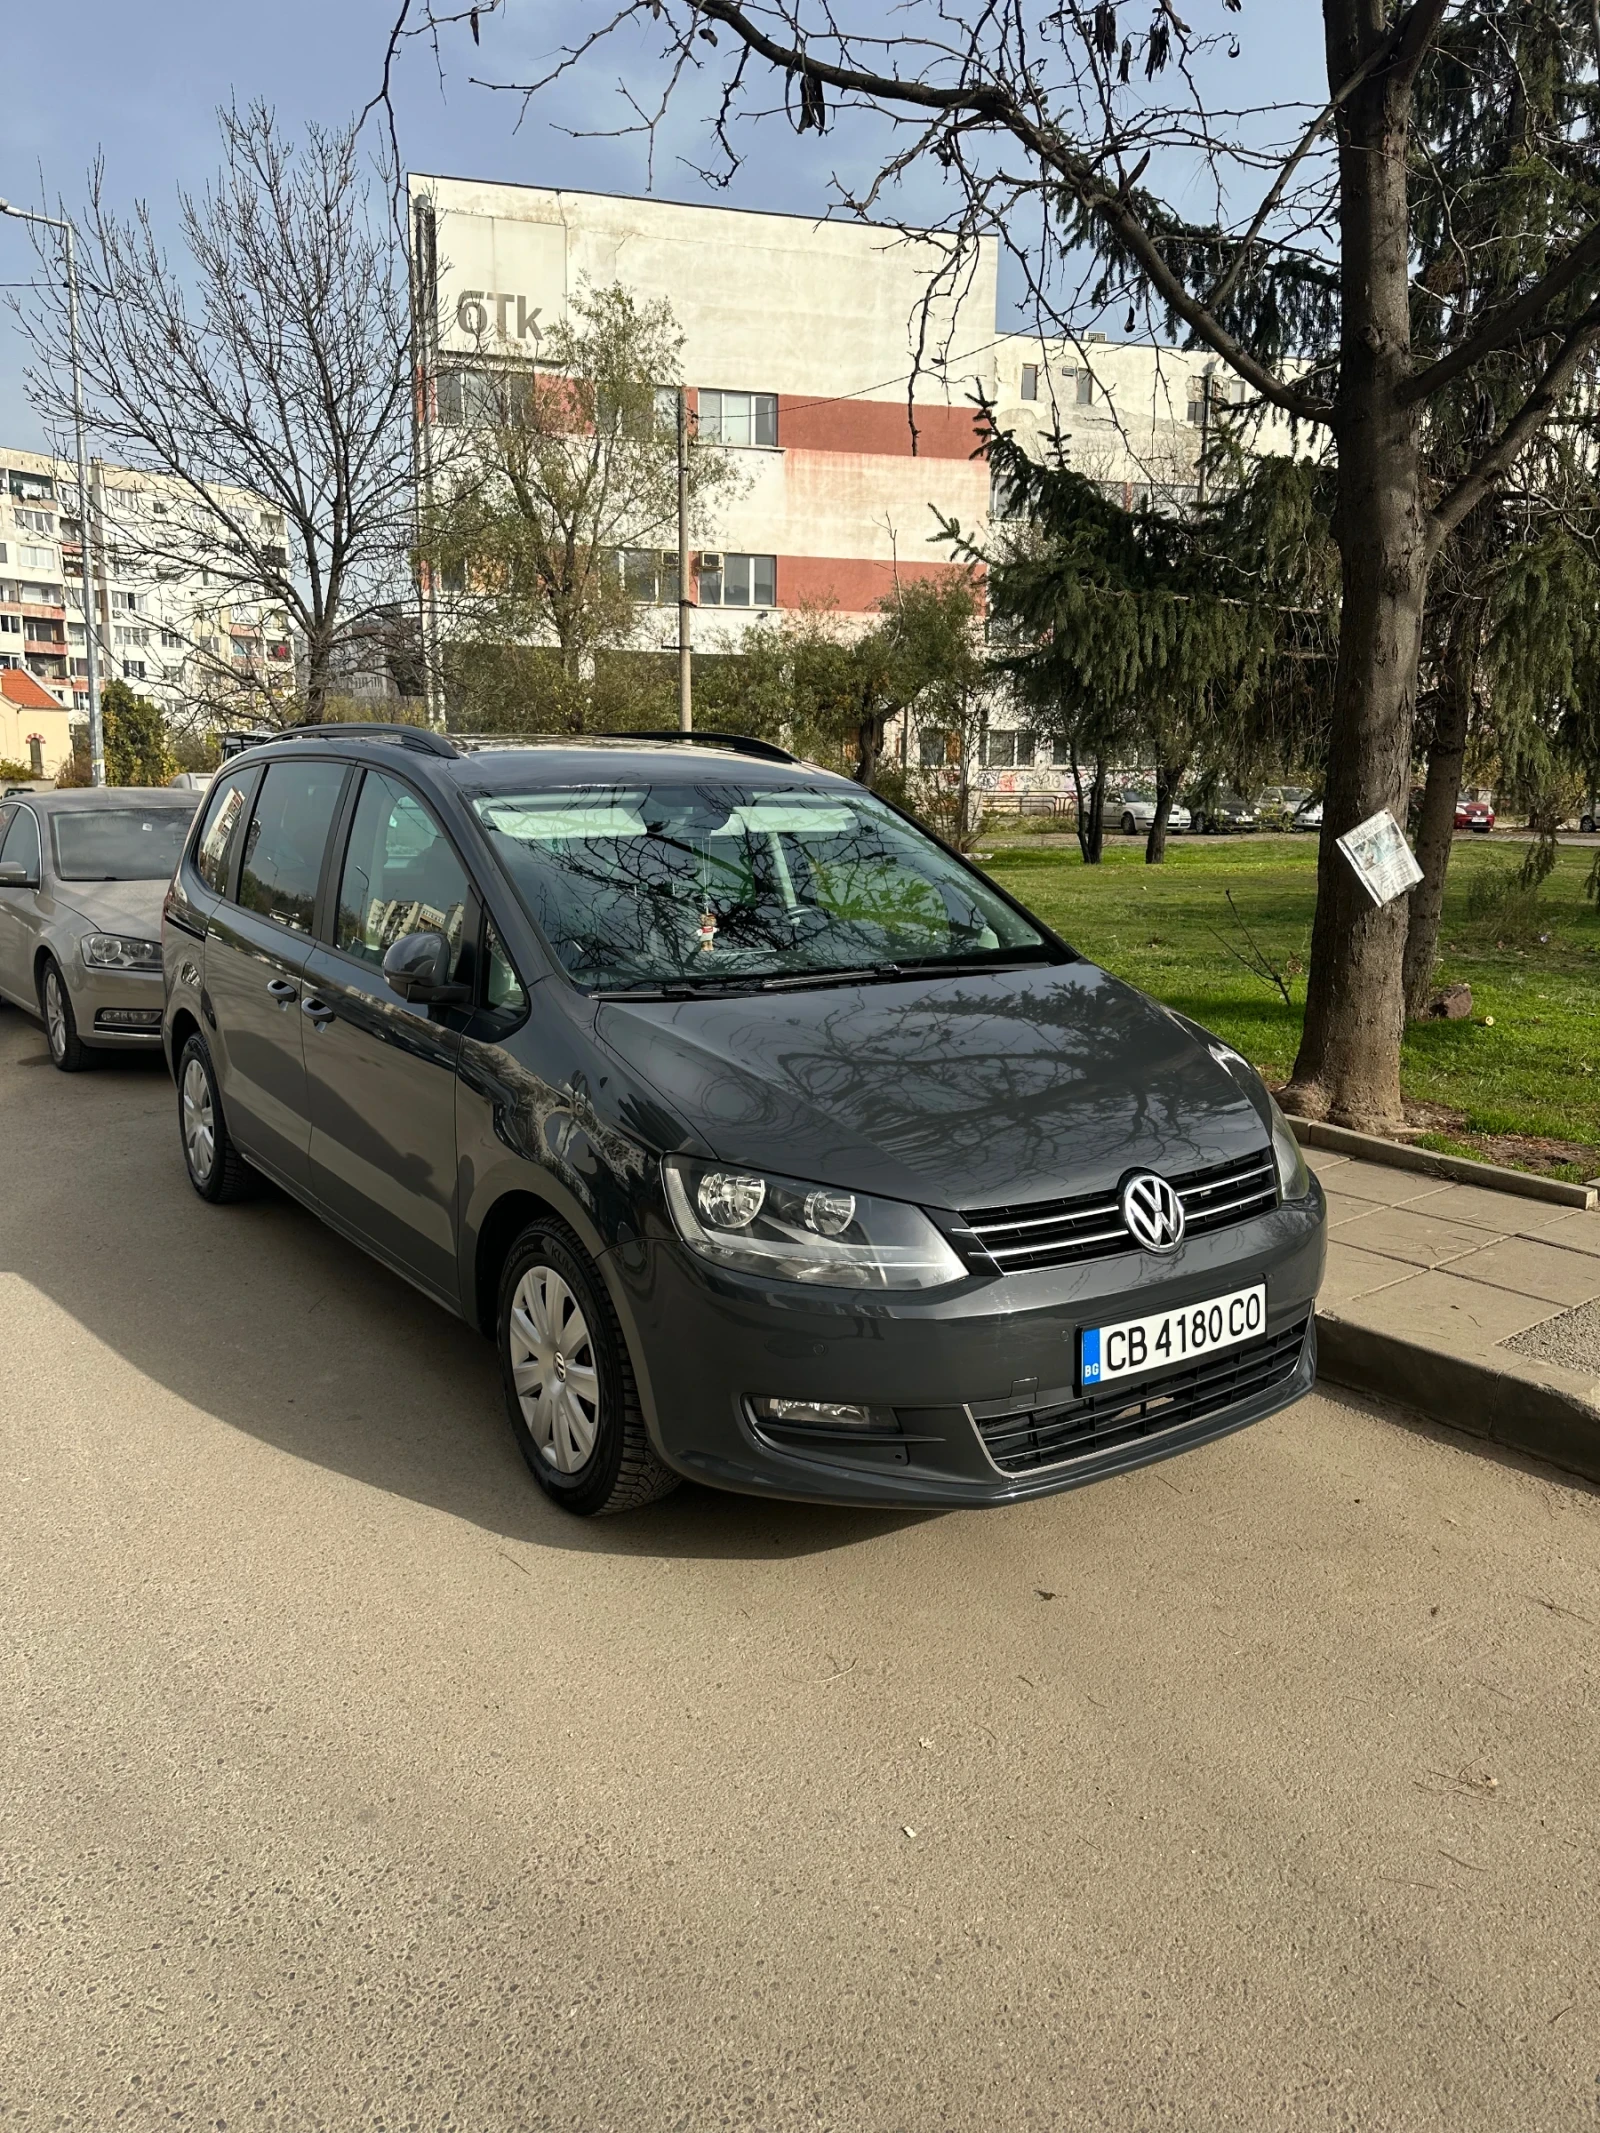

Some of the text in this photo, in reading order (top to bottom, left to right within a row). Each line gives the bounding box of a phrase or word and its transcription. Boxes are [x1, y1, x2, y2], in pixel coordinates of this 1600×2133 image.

[1084, 1363, 1099, 1377] BG
[1107, 1326, 1148, 1371] CB
[1155, 1305, 1223, 1358] 4180
